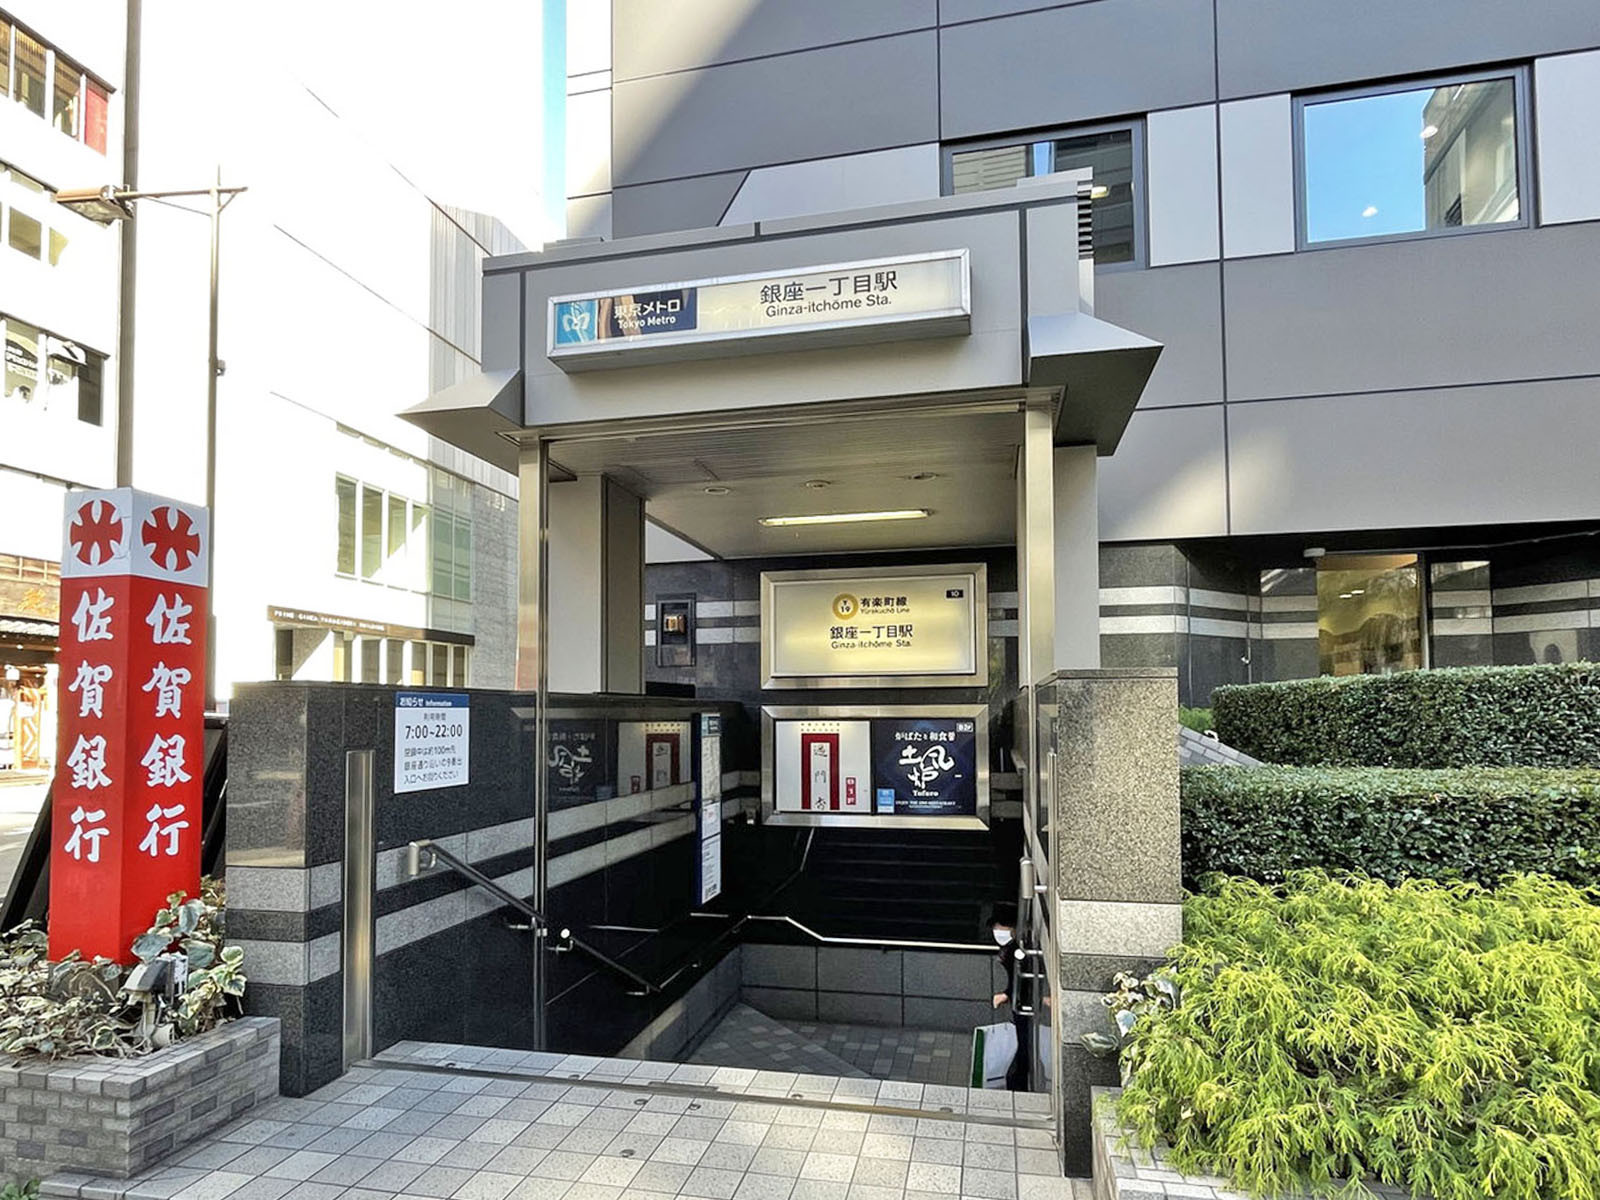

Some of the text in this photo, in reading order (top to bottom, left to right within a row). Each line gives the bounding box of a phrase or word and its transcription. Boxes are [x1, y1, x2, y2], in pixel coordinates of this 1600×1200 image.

[760, 271, 898, 304] 銀座一丁目駅
[866, 293, 892, 307] Sta.
[614, 299, 680, 319] 東京メトロ
[617, 314, 676, 329] Tokyo Metro
[840, 604, 851, 613] 19
[860, 596, 907, 608] 有楽町線
[830, 624, 913, 640] 銀座一丁目駅
[896, 638, 912, 648] Sta.
[399, 696, 424, 707] お知らせ
[64, 587, 115, 863] 佐賀銀行
[139, 592, 194, 859] 佐賀銀行
